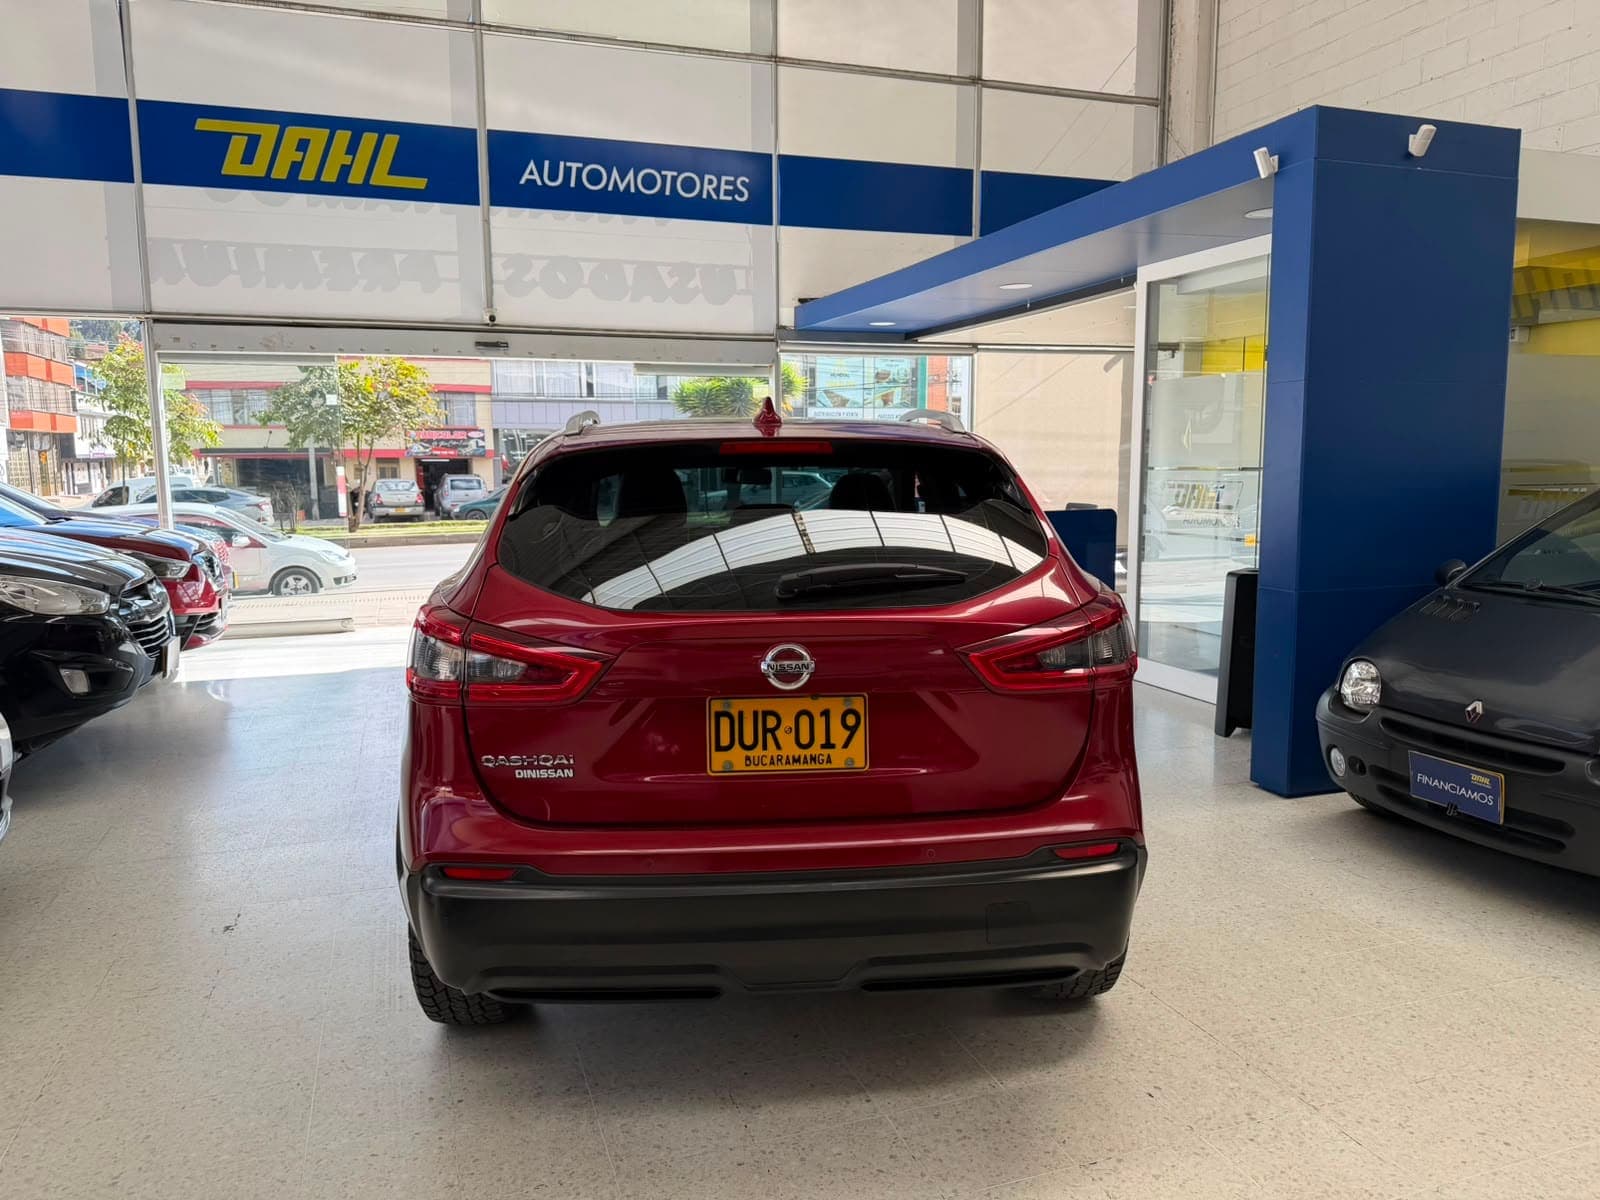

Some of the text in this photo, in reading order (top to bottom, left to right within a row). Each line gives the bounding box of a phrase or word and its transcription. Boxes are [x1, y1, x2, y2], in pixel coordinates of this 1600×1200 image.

[194, 117, 428, 190] DAHL
[519, 159, 750, 203] AUTOMOTORES
[766, 662, 810, 673] NISSAN
[714, 708, 862, 752] DUR 019
[514, 768, 574, 779] DINISSAN
[744, 753, 832, 767] BUCARAMANGA
[1416, 773, 1495, 806] FINANCIAMOS
